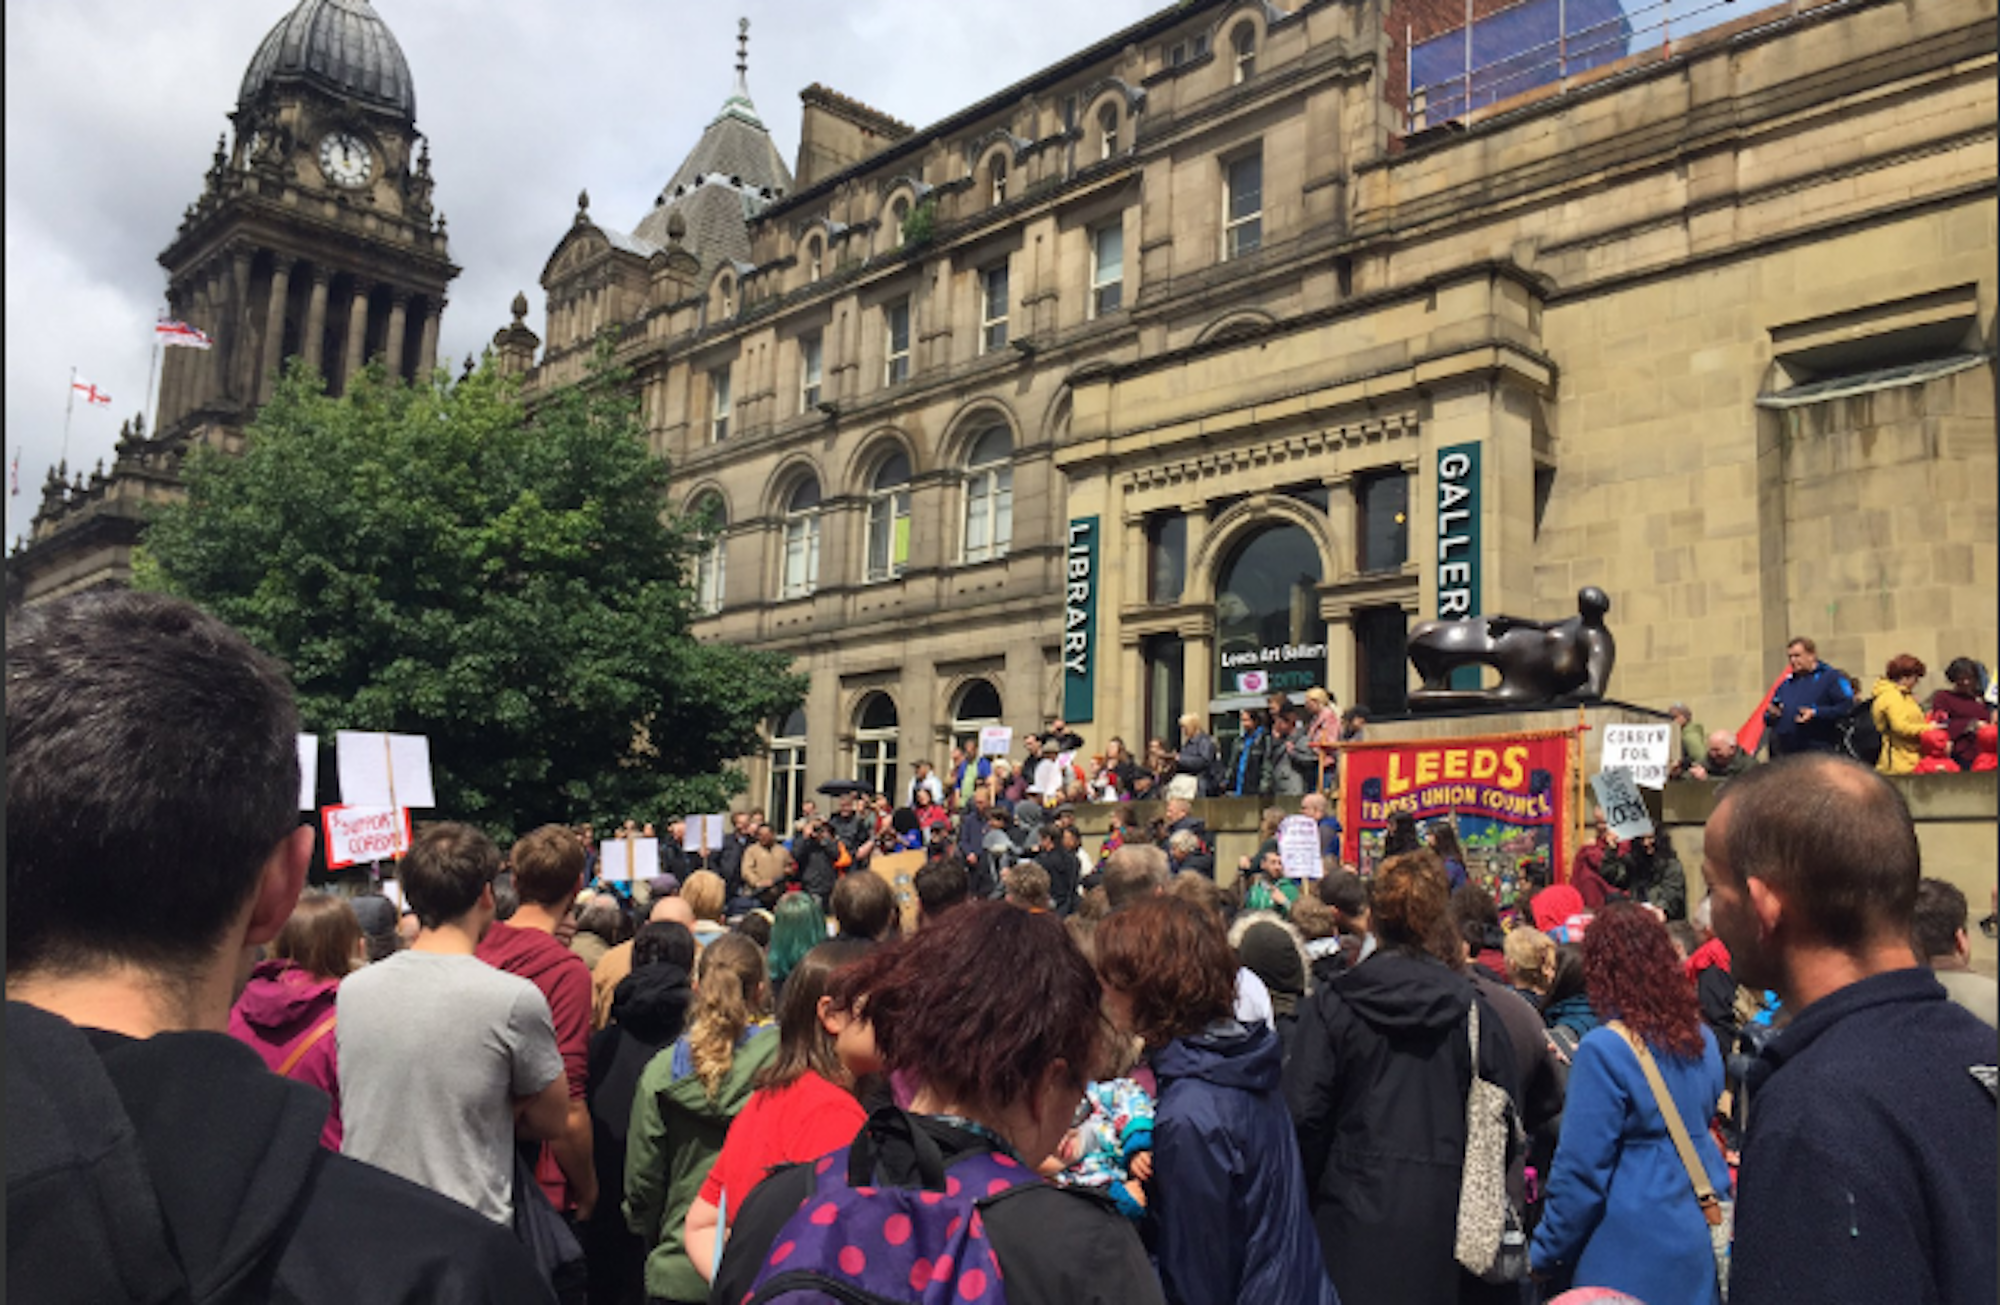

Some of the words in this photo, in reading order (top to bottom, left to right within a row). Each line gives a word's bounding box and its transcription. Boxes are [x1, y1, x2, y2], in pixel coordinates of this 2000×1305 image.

[1438, 452, 1471, 621] GALLER
[1065, 523, 1091, 674] LIBRARY
[1260, 645, 1280, 661] Art
[1387, 746, 1529, 796] LEEDS
[1621, 746, 1650, 761] FOR
[1420, 784, 1476, 808] UNION
[1481, 789, 1551, 817] COUNCL
